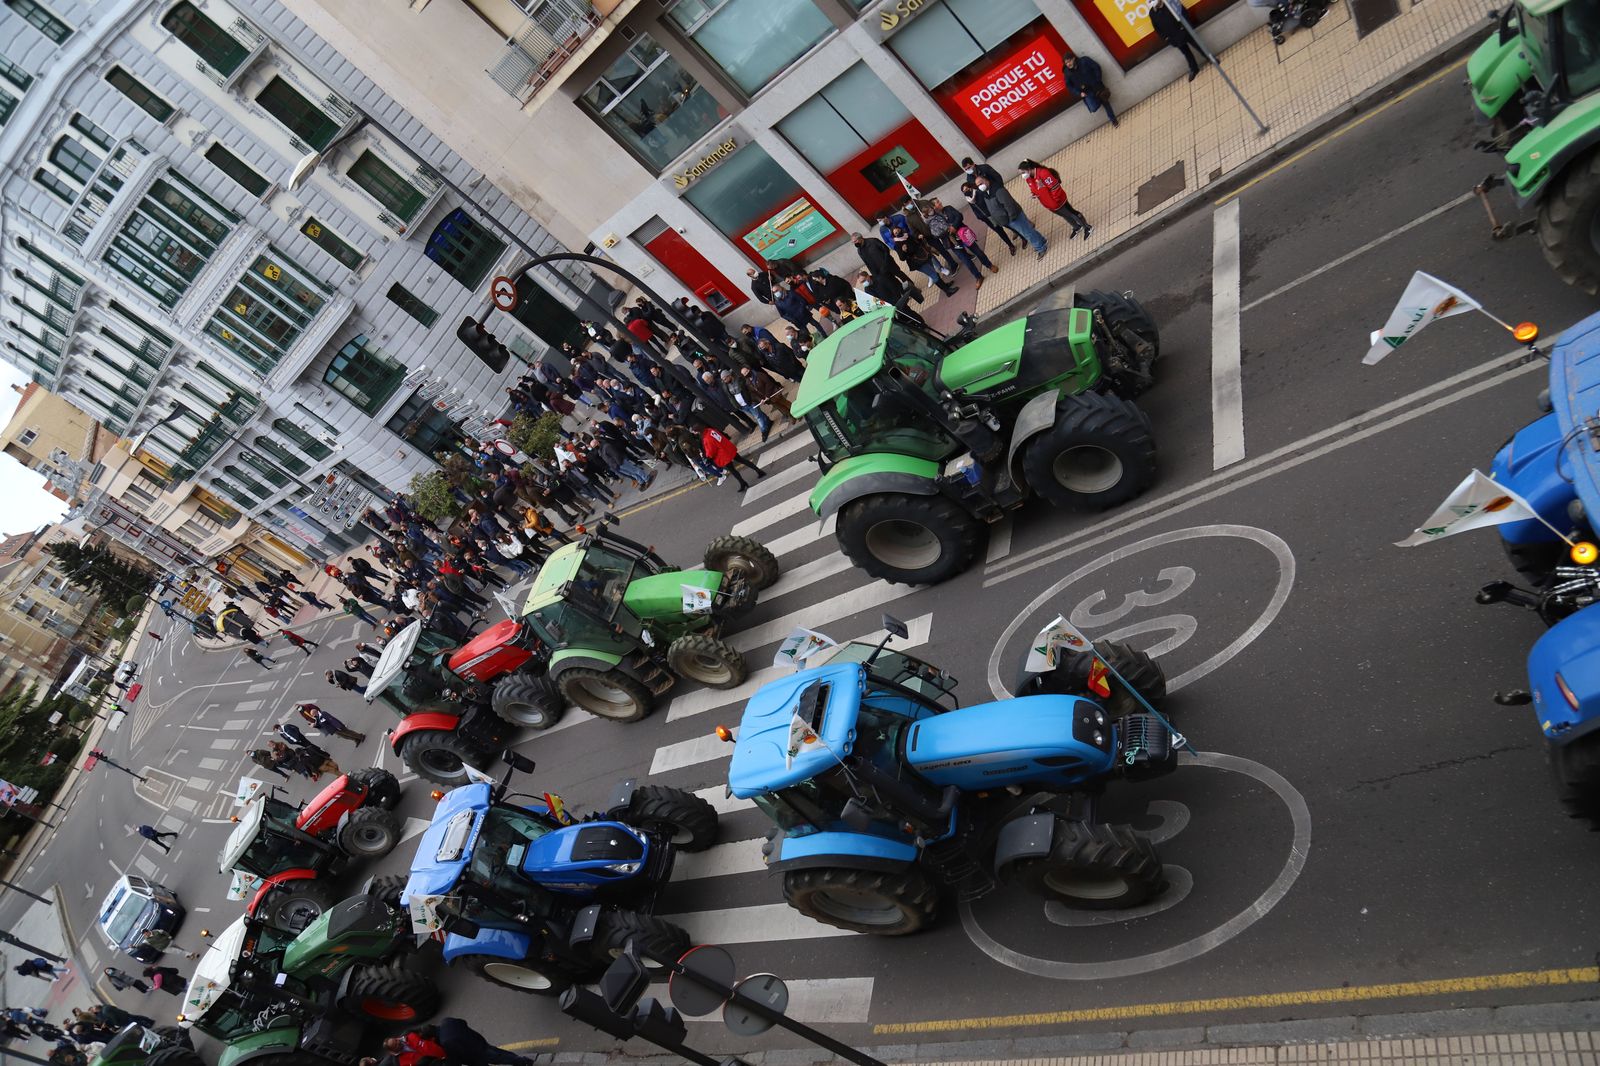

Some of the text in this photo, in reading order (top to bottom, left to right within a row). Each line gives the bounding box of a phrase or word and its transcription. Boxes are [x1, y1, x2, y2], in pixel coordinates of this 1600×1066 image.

[896, 0, 923, 18] Sa
[970, 65, 1027, 108] PORQUE
[1023, 50, 1046, 71] TÚ
[981, 78, 1038, 119] PORQUE
[1033, 66, 1056, 84] TE
[684, 137, 737, 181] Santander
